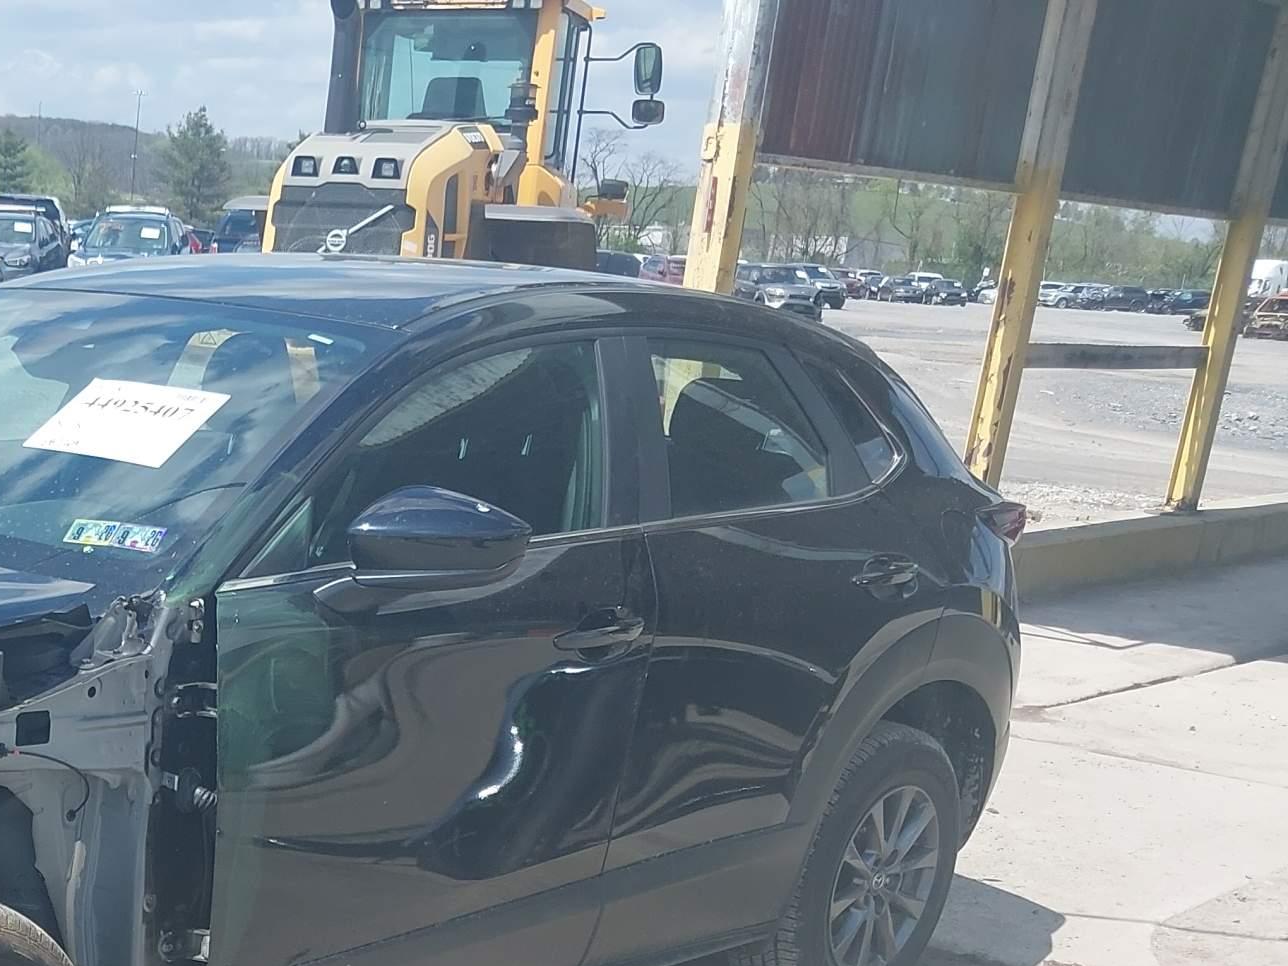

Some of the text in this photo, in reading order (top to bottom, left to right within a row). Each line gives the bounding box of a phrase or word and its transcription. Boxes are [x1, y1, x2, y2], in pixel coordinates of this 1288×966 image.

[81, 396, 196, 420] 44925407
[73, 526, 85, 541] 9
[118, 530, 130, 545] 9
